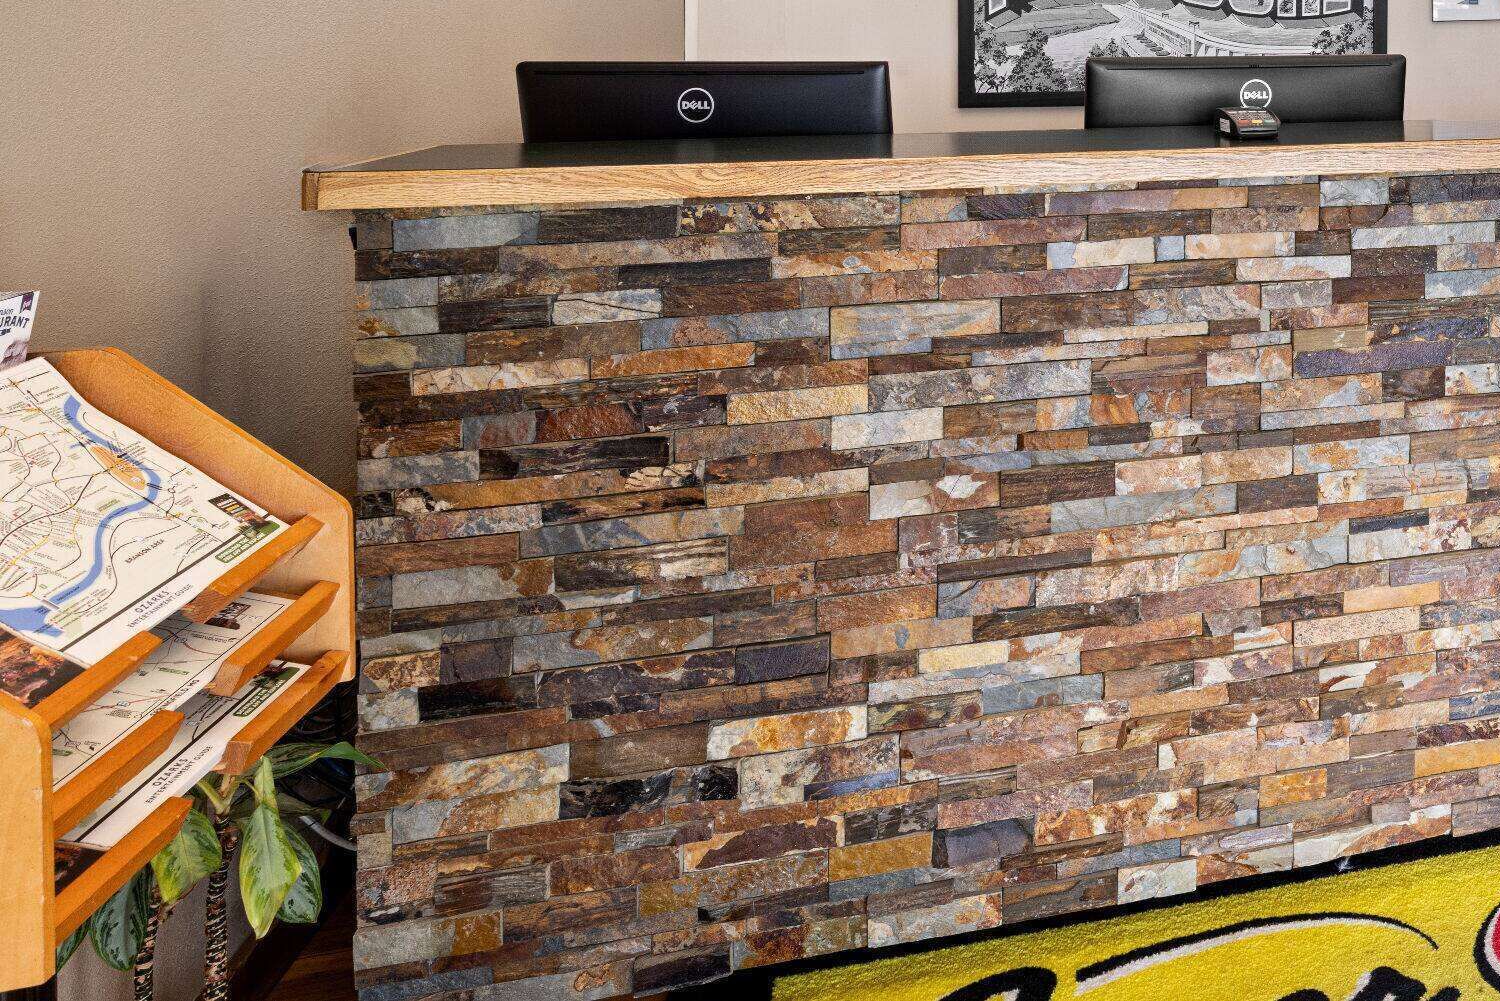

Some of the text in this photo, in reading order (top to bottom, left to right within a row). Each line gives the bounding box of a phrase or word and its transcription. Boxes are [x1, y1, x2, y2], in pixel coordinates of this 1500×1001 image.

[1243, 91, 1268, 100] DELL
[681, 100, 710, 110] DELL
[134, 587, 170, 614] OZARKS
[152, 757, 189, 788] OZARKS
